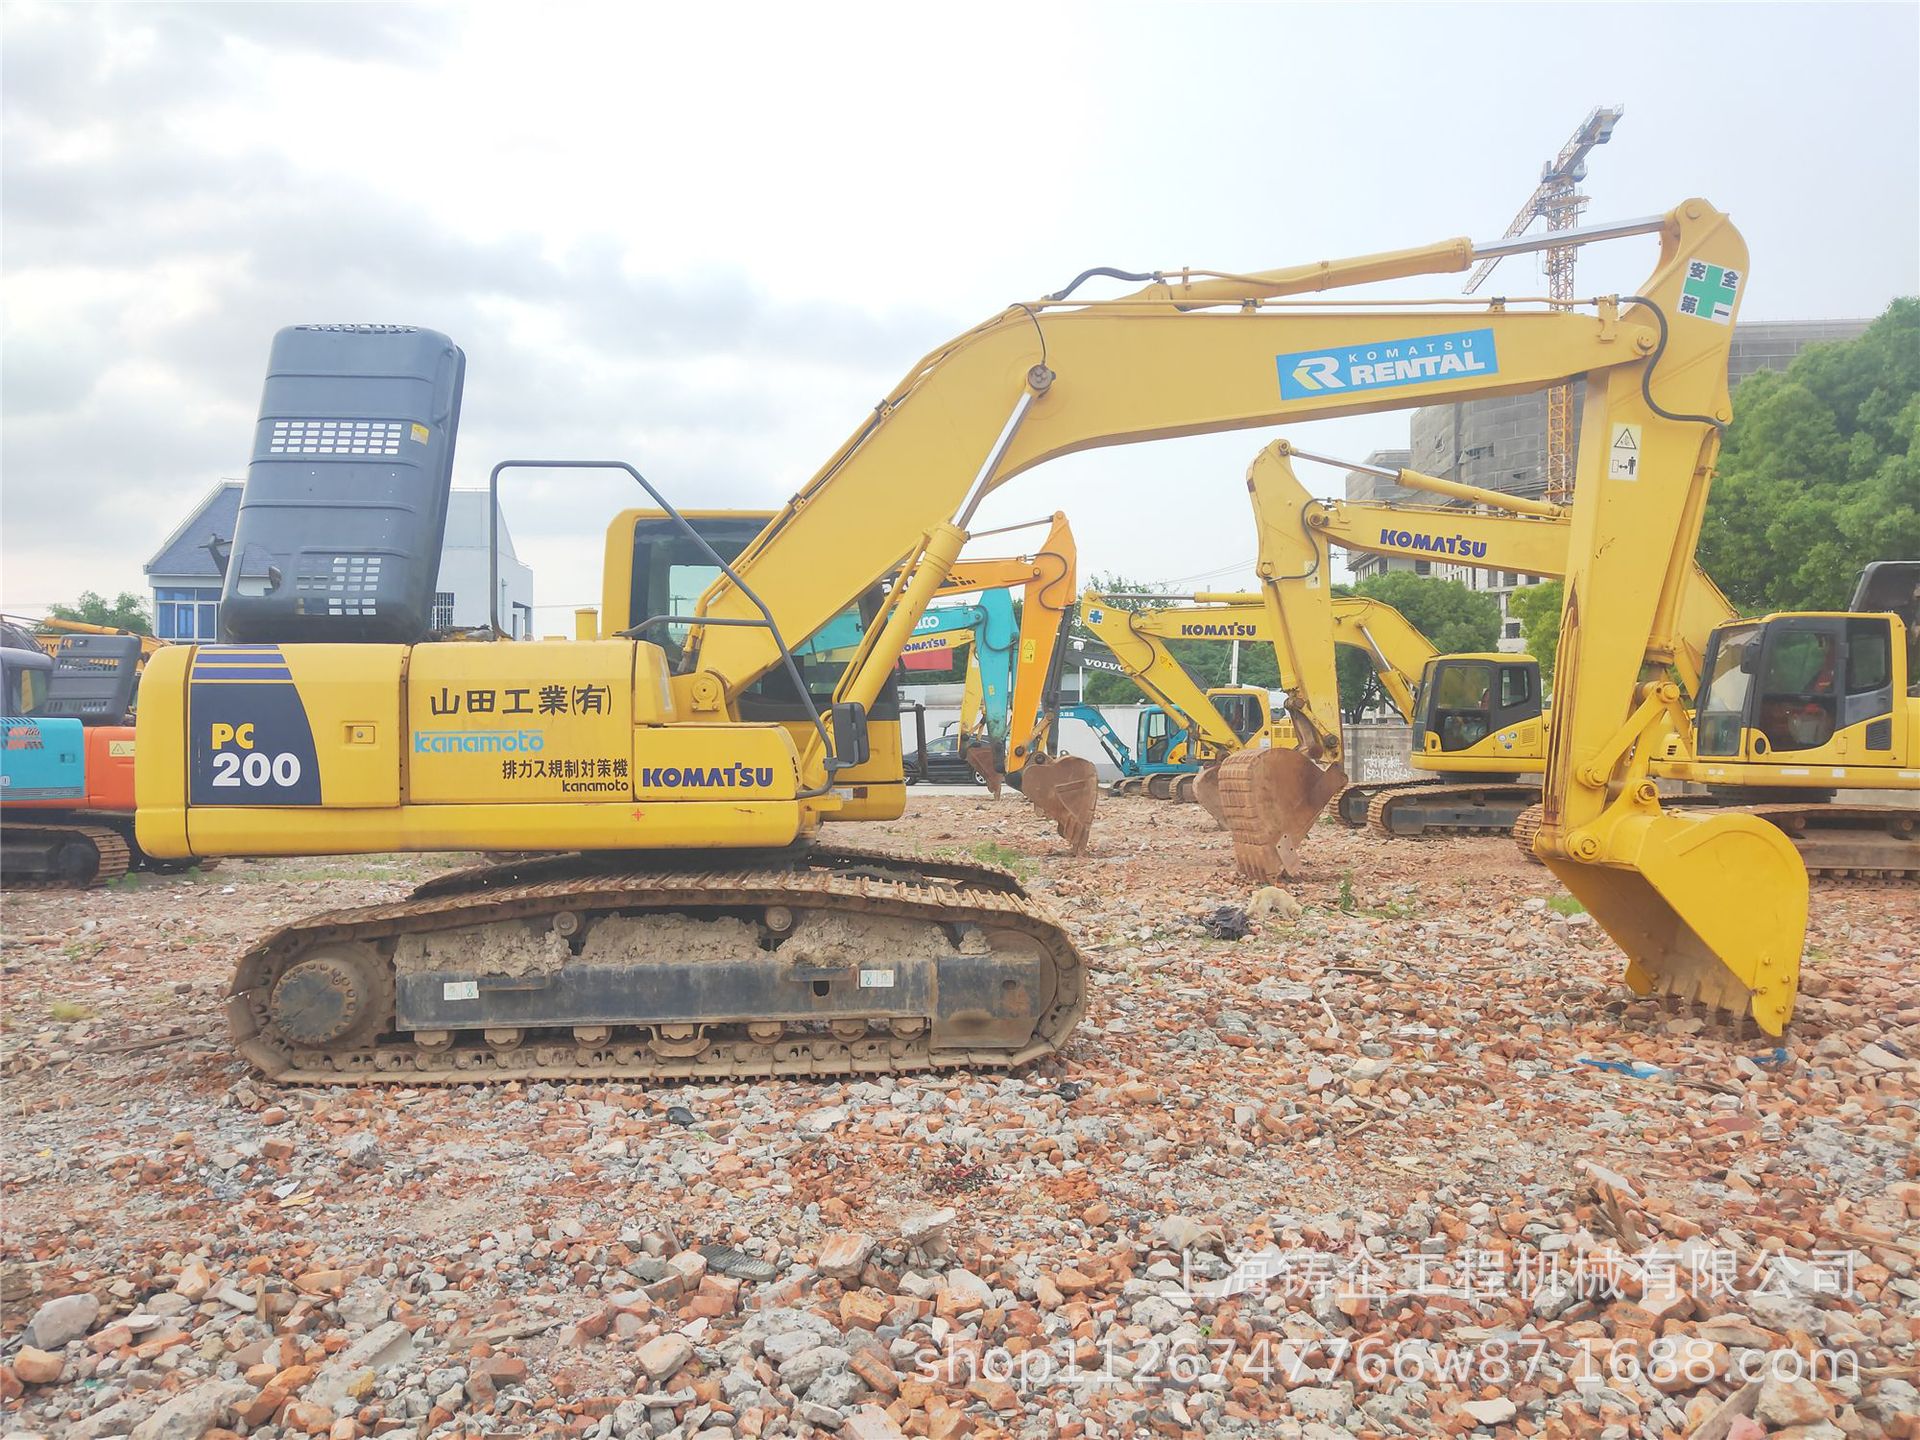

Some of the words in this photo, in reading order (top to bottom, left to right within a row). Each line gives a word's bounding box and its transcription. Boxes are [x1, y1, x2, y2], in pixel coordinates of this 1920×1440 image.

[1348, 338, 1473, 363] KOMATSU
[1350, 351, 1486, 386] RENTAL
[1379, 528, 1487, 558] KOMATSU
[1181, 621, 1257, 637] KOMATSU
[902, 638, 947, 652] OMATSU
[211, 723, 254, 750] PC
[414, 730, 544, 753] kanamoto
[212, 752, 301, 787] 200
[502, 758, 629, 780] 排ガス規制対策機
[642, 761, 774, 788] KOMATSU
[562, 780, 629, 793] kanamoto
